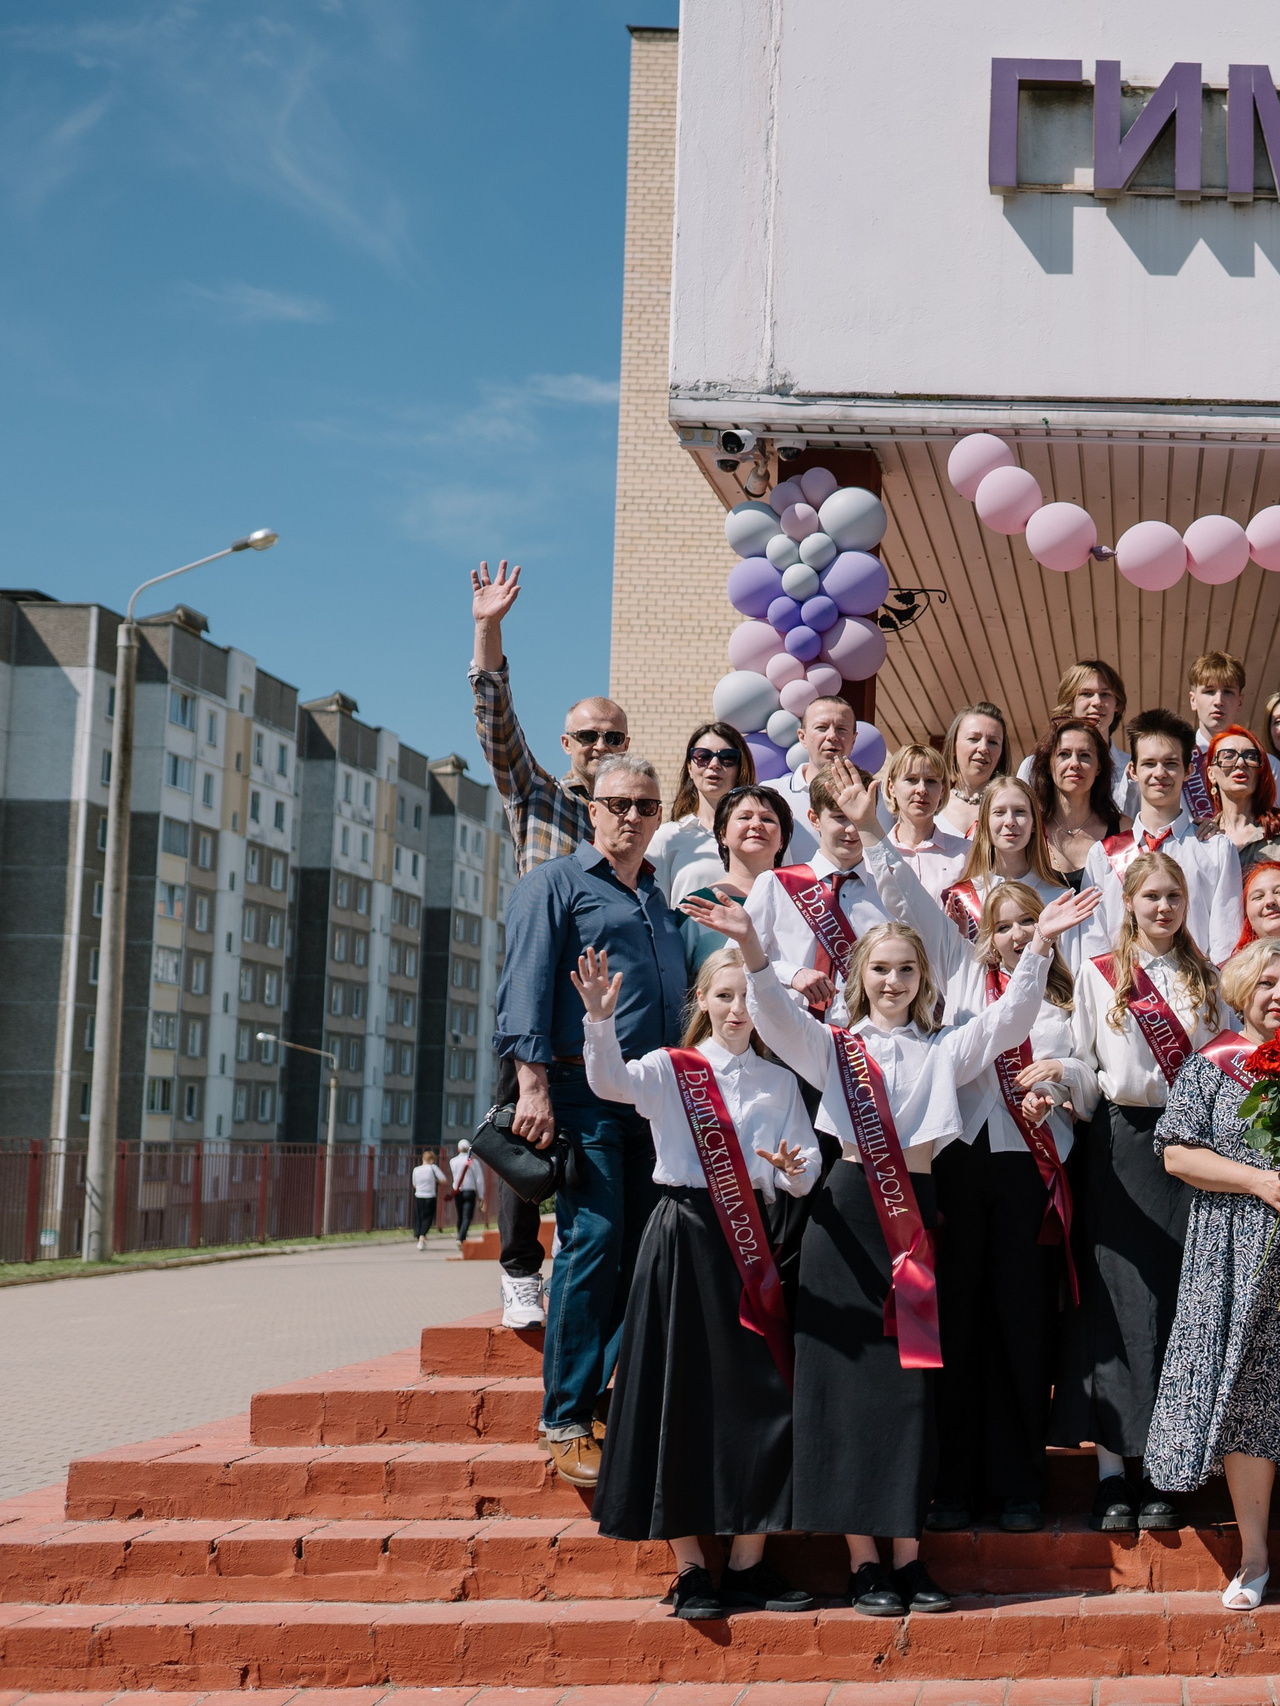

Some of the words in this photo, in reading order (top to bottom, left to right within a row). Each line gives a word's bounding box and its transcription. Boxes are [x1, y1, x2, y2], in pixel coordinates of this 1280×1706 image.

[801, 908, 816, 927] КЛАСС
[837, 1042, 847, 1063] КЛАСС
[1139, 1015, 1151, 1035] КЛАСС
[1149, 1035, 1168, 1068] ГИМНАЗИЯ
[841, 1064, 856, 1100] ГИМНАЗИЯ
[682, 1089, 693, 1111] КЛАСС
[707, 1173, 721, 1202] МИНСКА
[856, 1124, 868, 1153] МИНСКА
[684, 1067, 743, 1214] ВЫПУСКНИЦА
[731, 1215, 761, 1265] 2024
[876, 1166, 908, 1217] 2024
